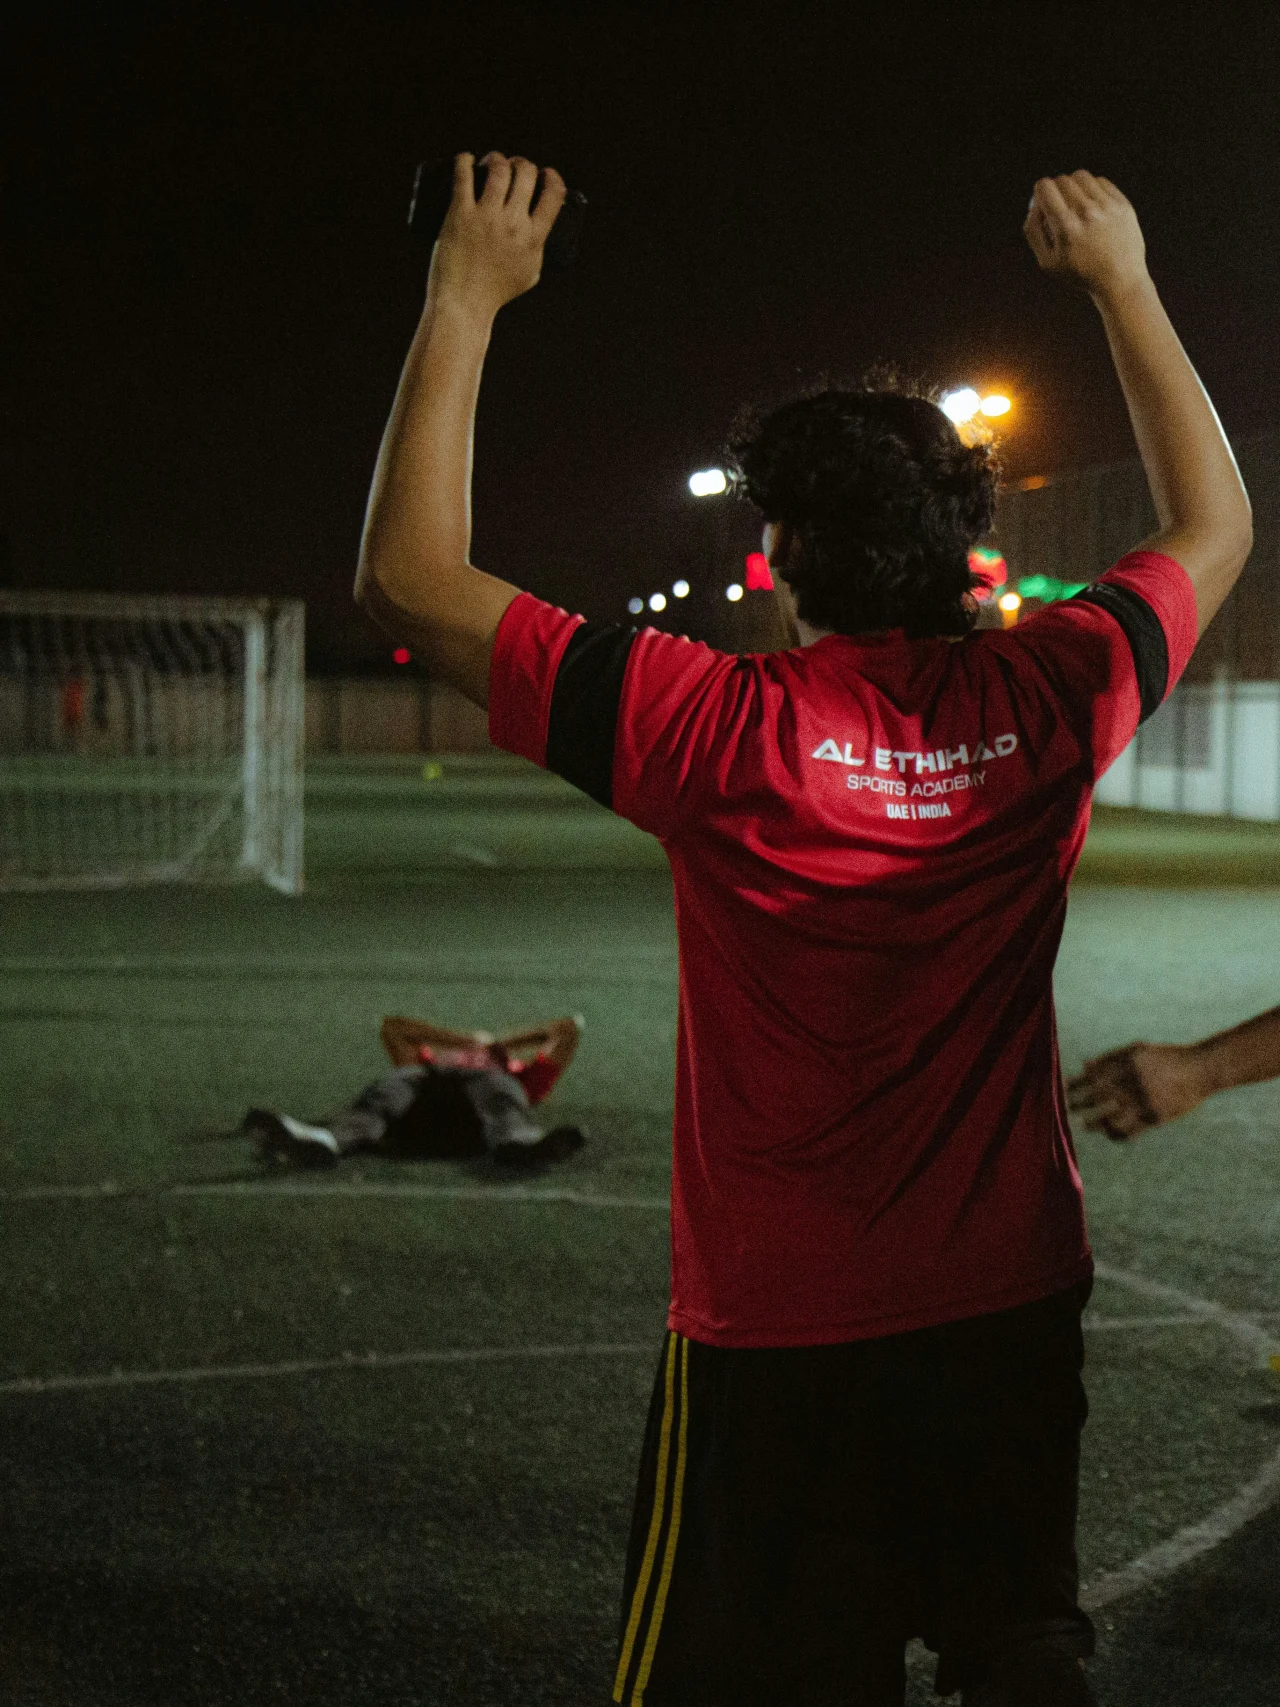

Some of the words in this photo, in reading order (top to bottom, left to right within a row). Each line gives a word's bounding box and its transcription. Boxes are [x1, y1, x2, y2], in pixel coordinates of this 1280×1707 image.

[811, 738, 865, 767] AL
[875, 733, 1018, 774] ETHIHAD
[847, 774, 906, 796] SPORTS
[911, 771, 986, 797] ACADEMY
[886, 803, 908, 820] UAE
[918, 802, 951, 819] INDIA
